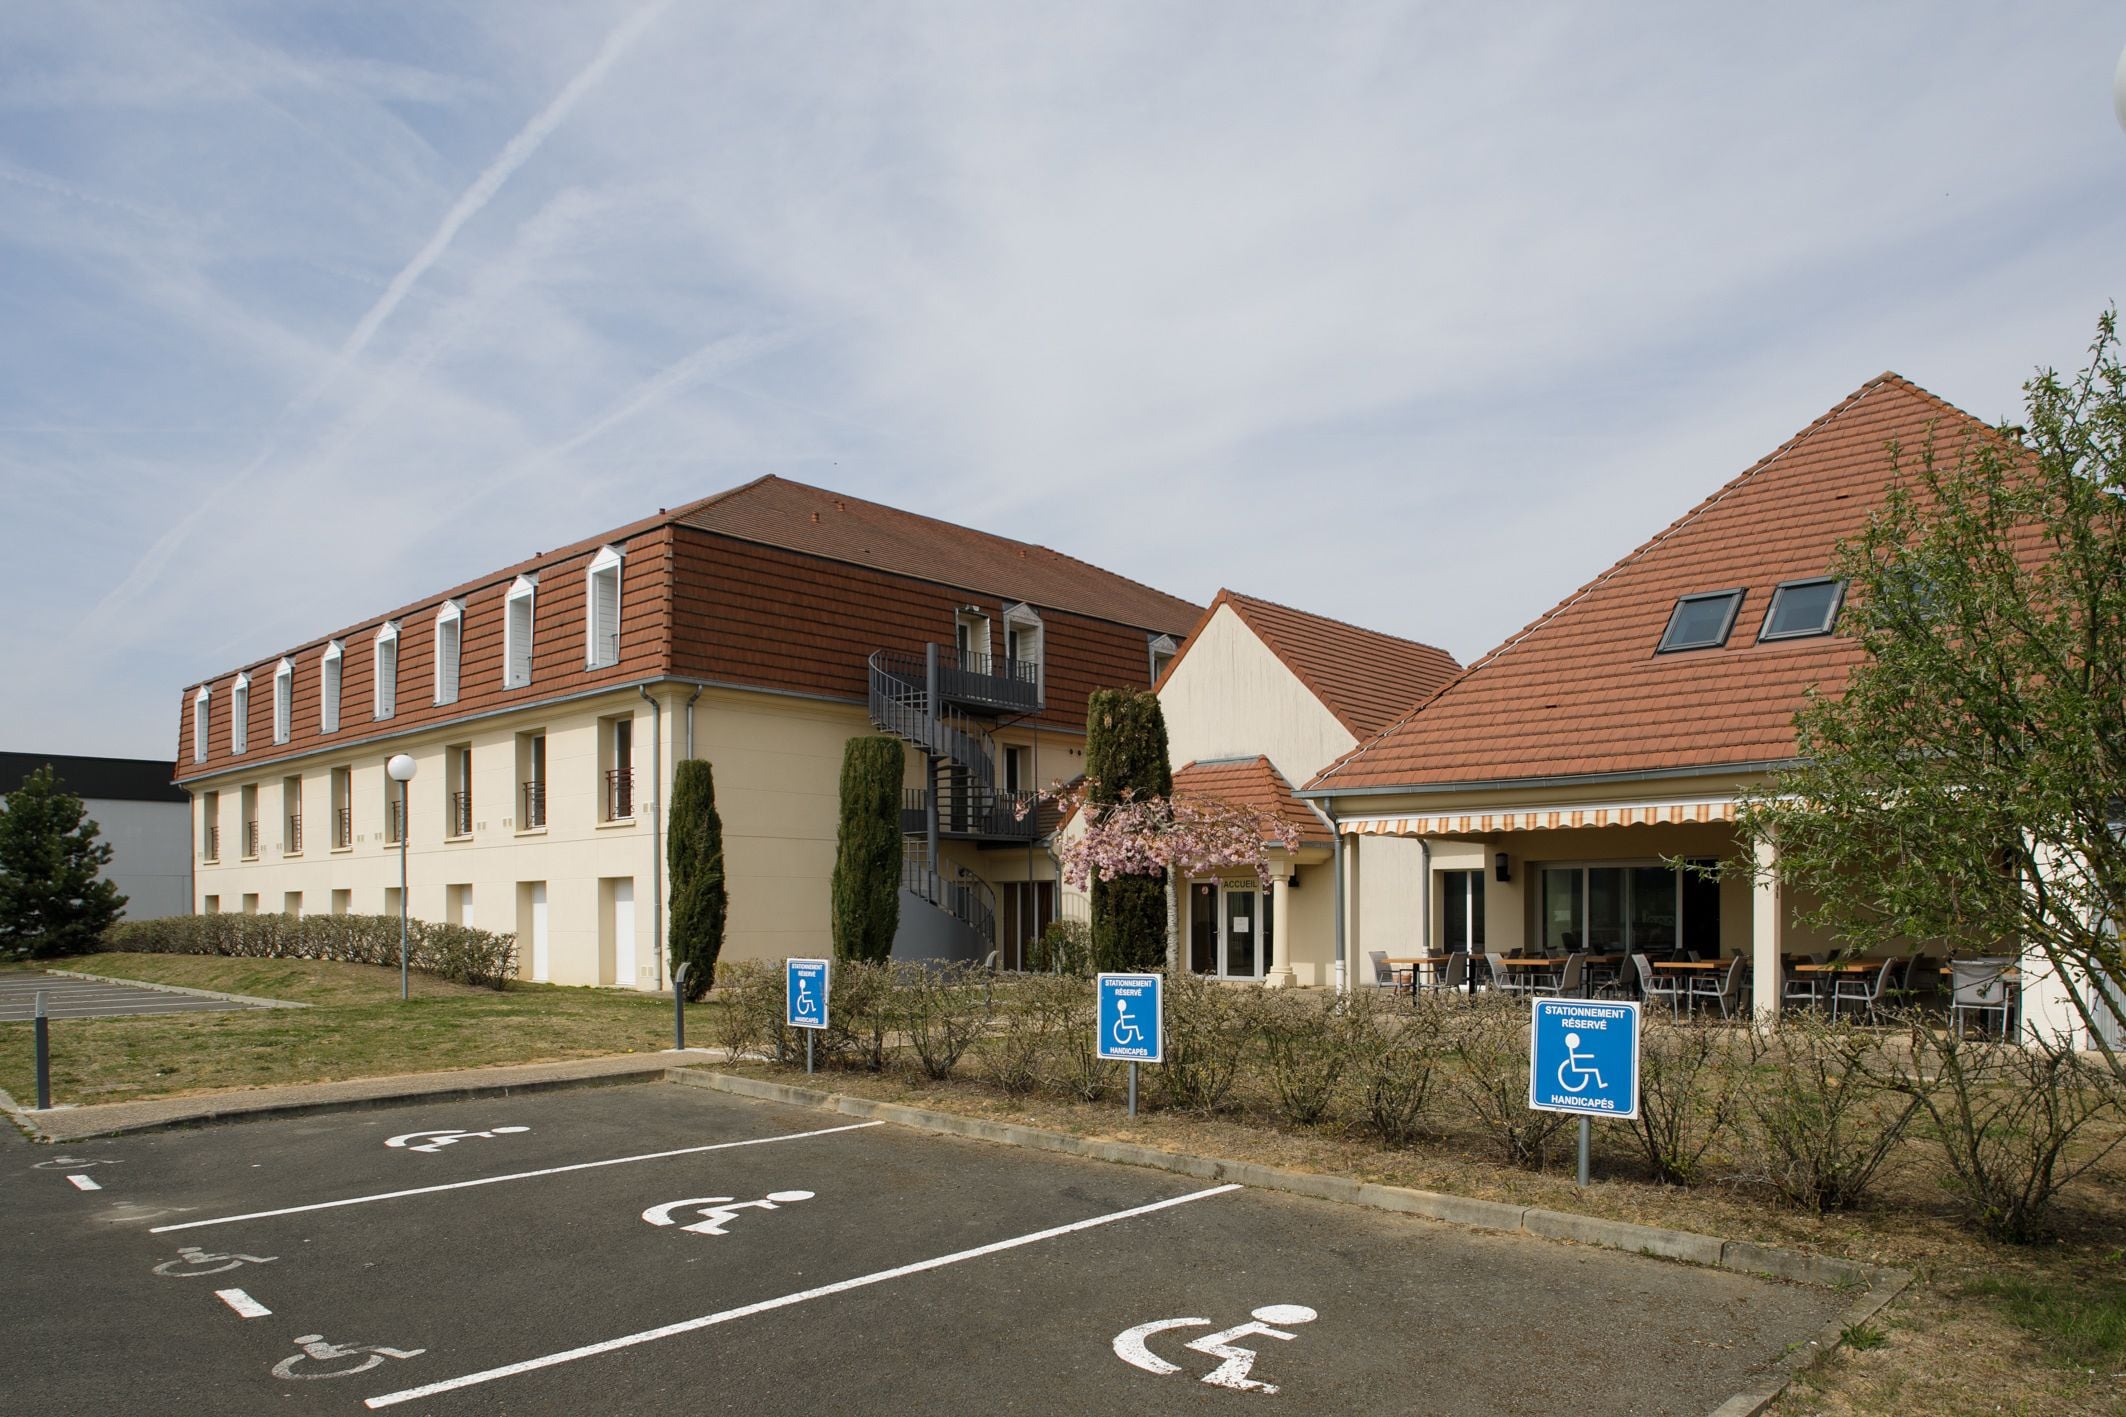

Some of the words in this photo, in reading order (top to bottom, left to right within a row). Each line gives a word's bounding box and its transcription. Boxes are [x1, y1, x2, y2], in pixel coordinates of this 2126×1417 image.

[1223, 880, 1257, 888] ACCUEIL
[1105, 979, 1152, 987] STATIONNEMENT
[1115, 988, 1142, 996] RÉSERVÉ
[1545, 1005, 1625, 1019] STATIONNEMENT
[1561, 1017, 1607, 1030] RÉSERVÉ
[1110, 1046, 1148, 1056] HANDICAPÉS
[1551, 1094, 1615, 1110] HANDICAPÉS
